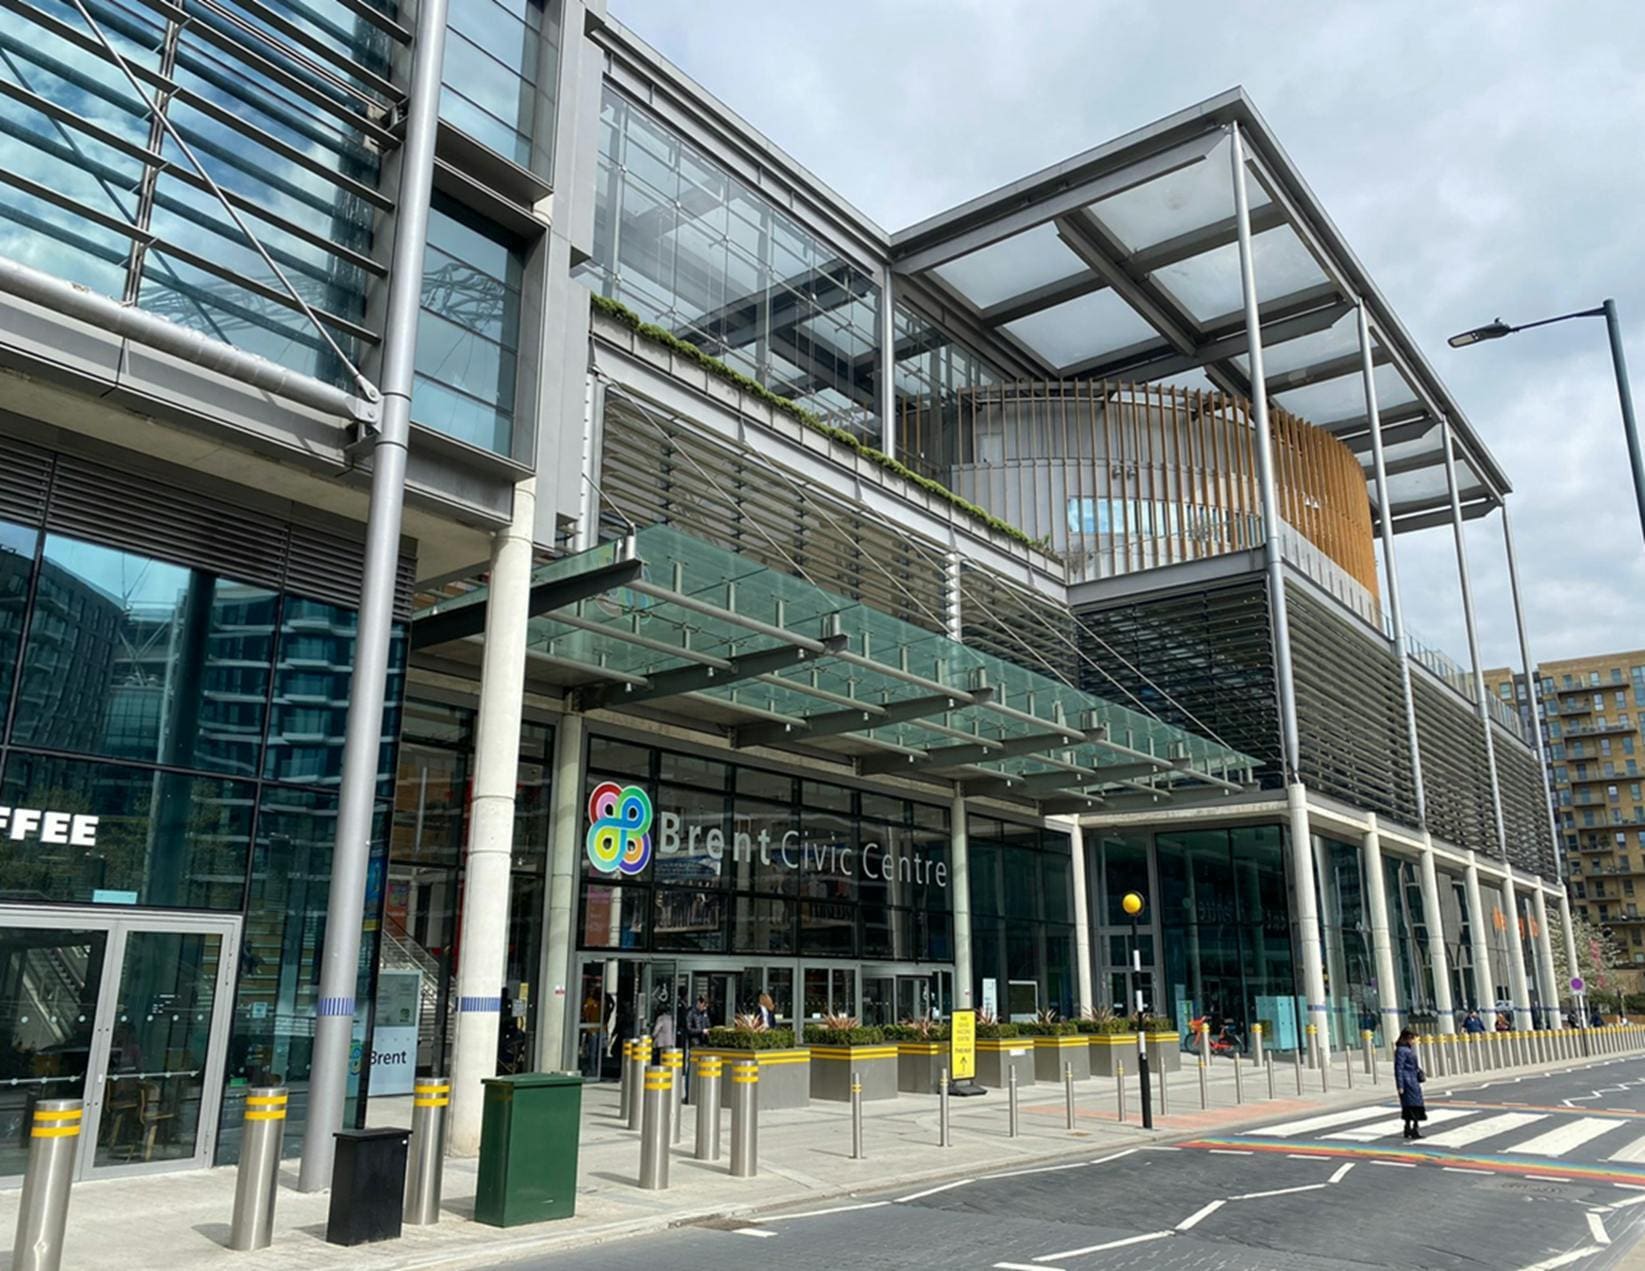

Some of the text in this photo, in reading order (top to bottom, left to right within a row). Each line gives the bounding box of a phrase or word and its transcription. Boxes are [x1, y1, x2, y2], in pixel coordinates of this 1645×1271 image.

[659, 811, 947, 887] Brent Civic Centre
[370, 1050, 407, 1065] Brent
